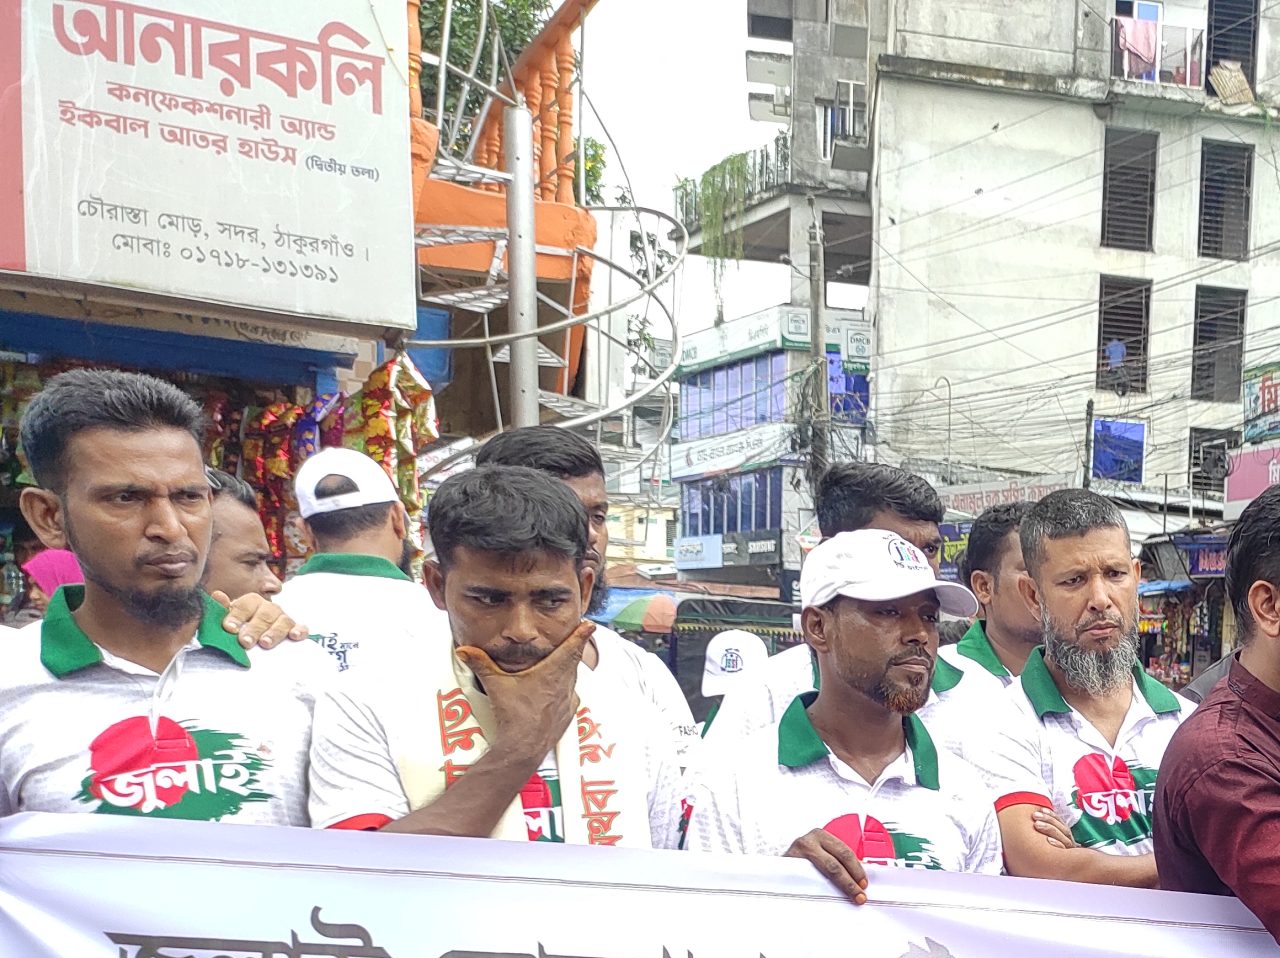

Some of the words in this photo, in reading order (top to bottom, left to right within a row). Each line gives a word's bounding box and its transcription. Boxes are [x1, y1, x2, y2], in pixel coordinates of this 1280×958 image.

[53, 0, 385, 115] আনারকলি
[59, 100, 150, 139] ইকবাল
[159, 122, 228, 155] আতর
[238, 138, 297, 166] হাউস
[106, 81, 271, 131] কনফেকশনারী
[77, 195, 148, 226] চৌরাস্তা
[158, 211, 210, 239] মোড়,
[216, 221, 265, 248] সদর,
[273, 224, 355, 259] ঠাকুরগাঁও
[180, 246, 339, 284] ০১৭১৮-১৩১৩৯১
[101, 750, 252, 814] জুলাই
[1082, 788, 1156, 826] জুলা
